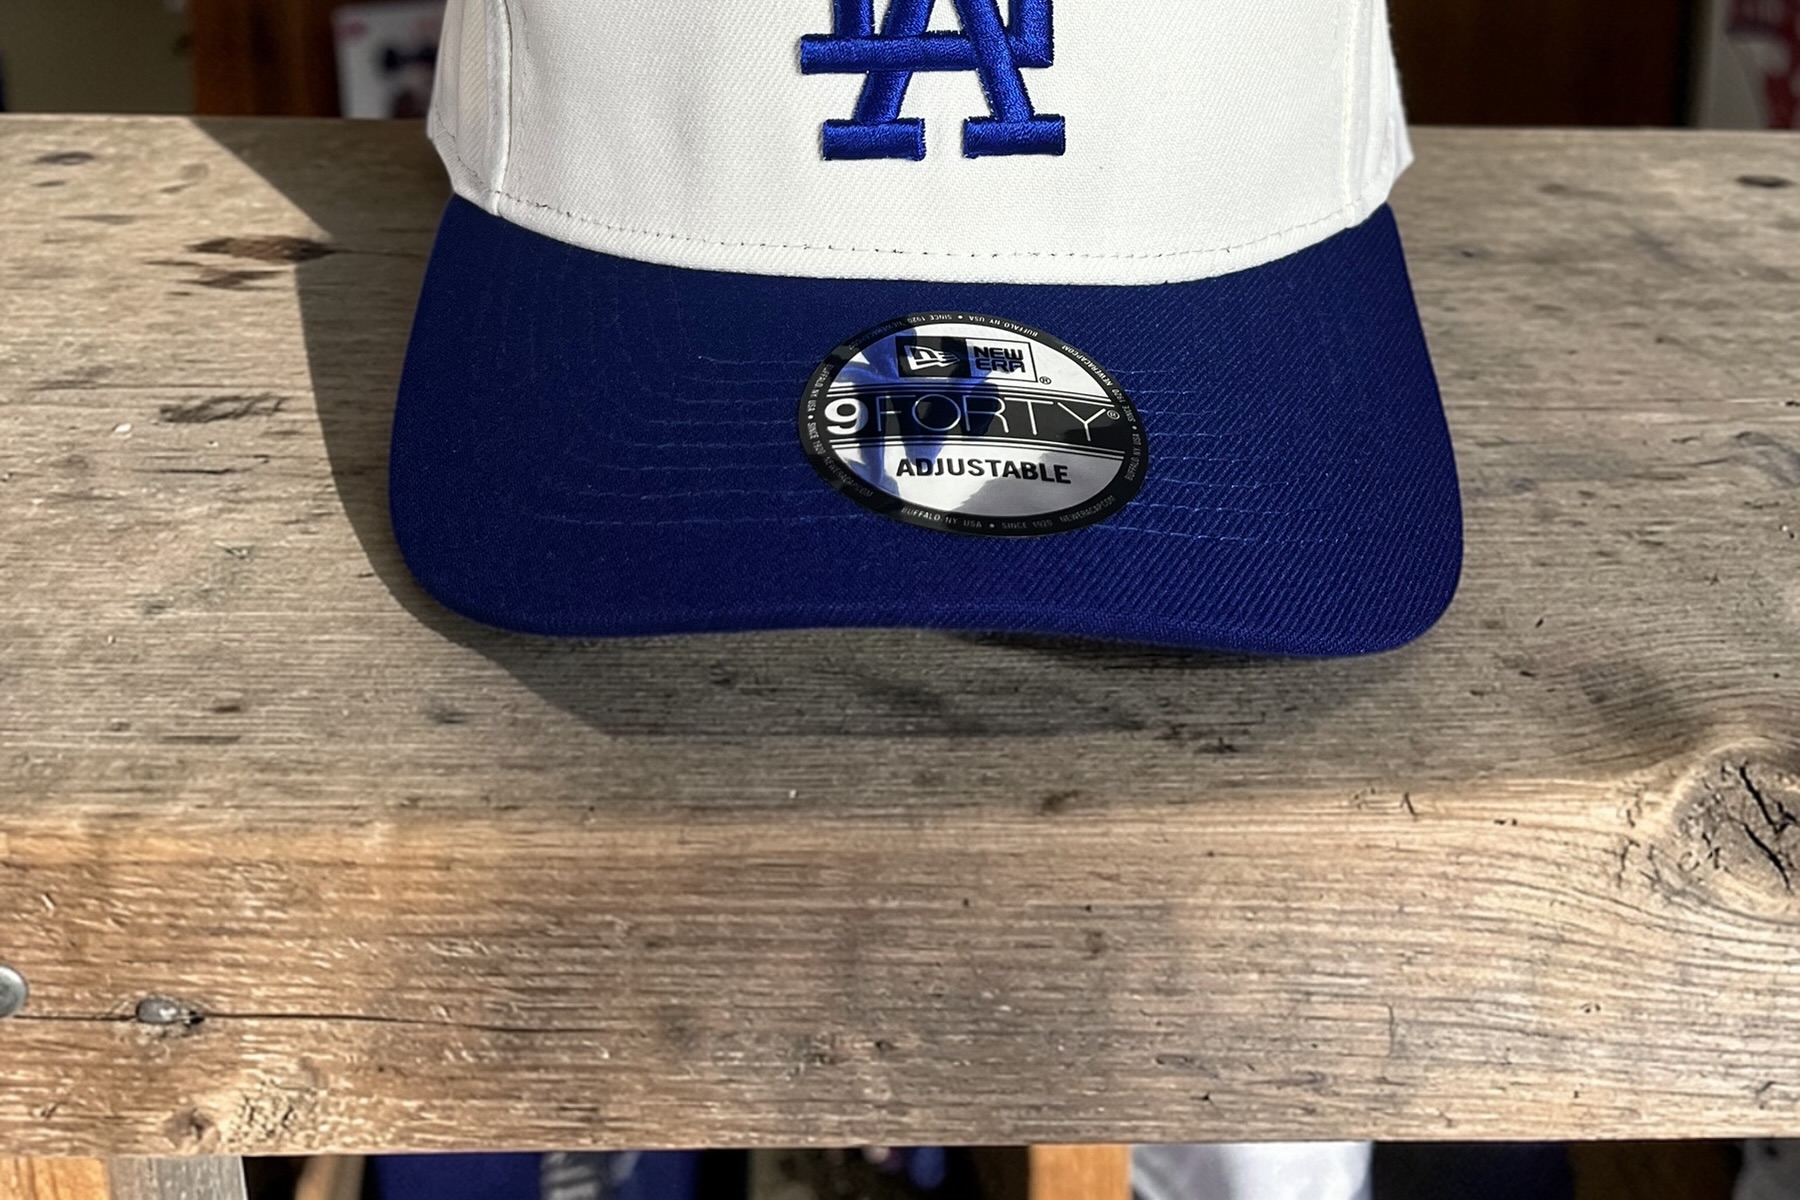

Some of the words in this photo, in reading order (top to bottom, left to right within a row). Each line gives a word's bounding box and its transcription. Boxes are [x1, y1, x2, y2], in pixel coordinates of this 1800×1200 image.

[973, 346, 1024, 361] NEW
[975, 358, 1026, 373] ERA
[896, 457, 1072, 484] ADJUSTABLE
[963, 520, 983, 528] USA
